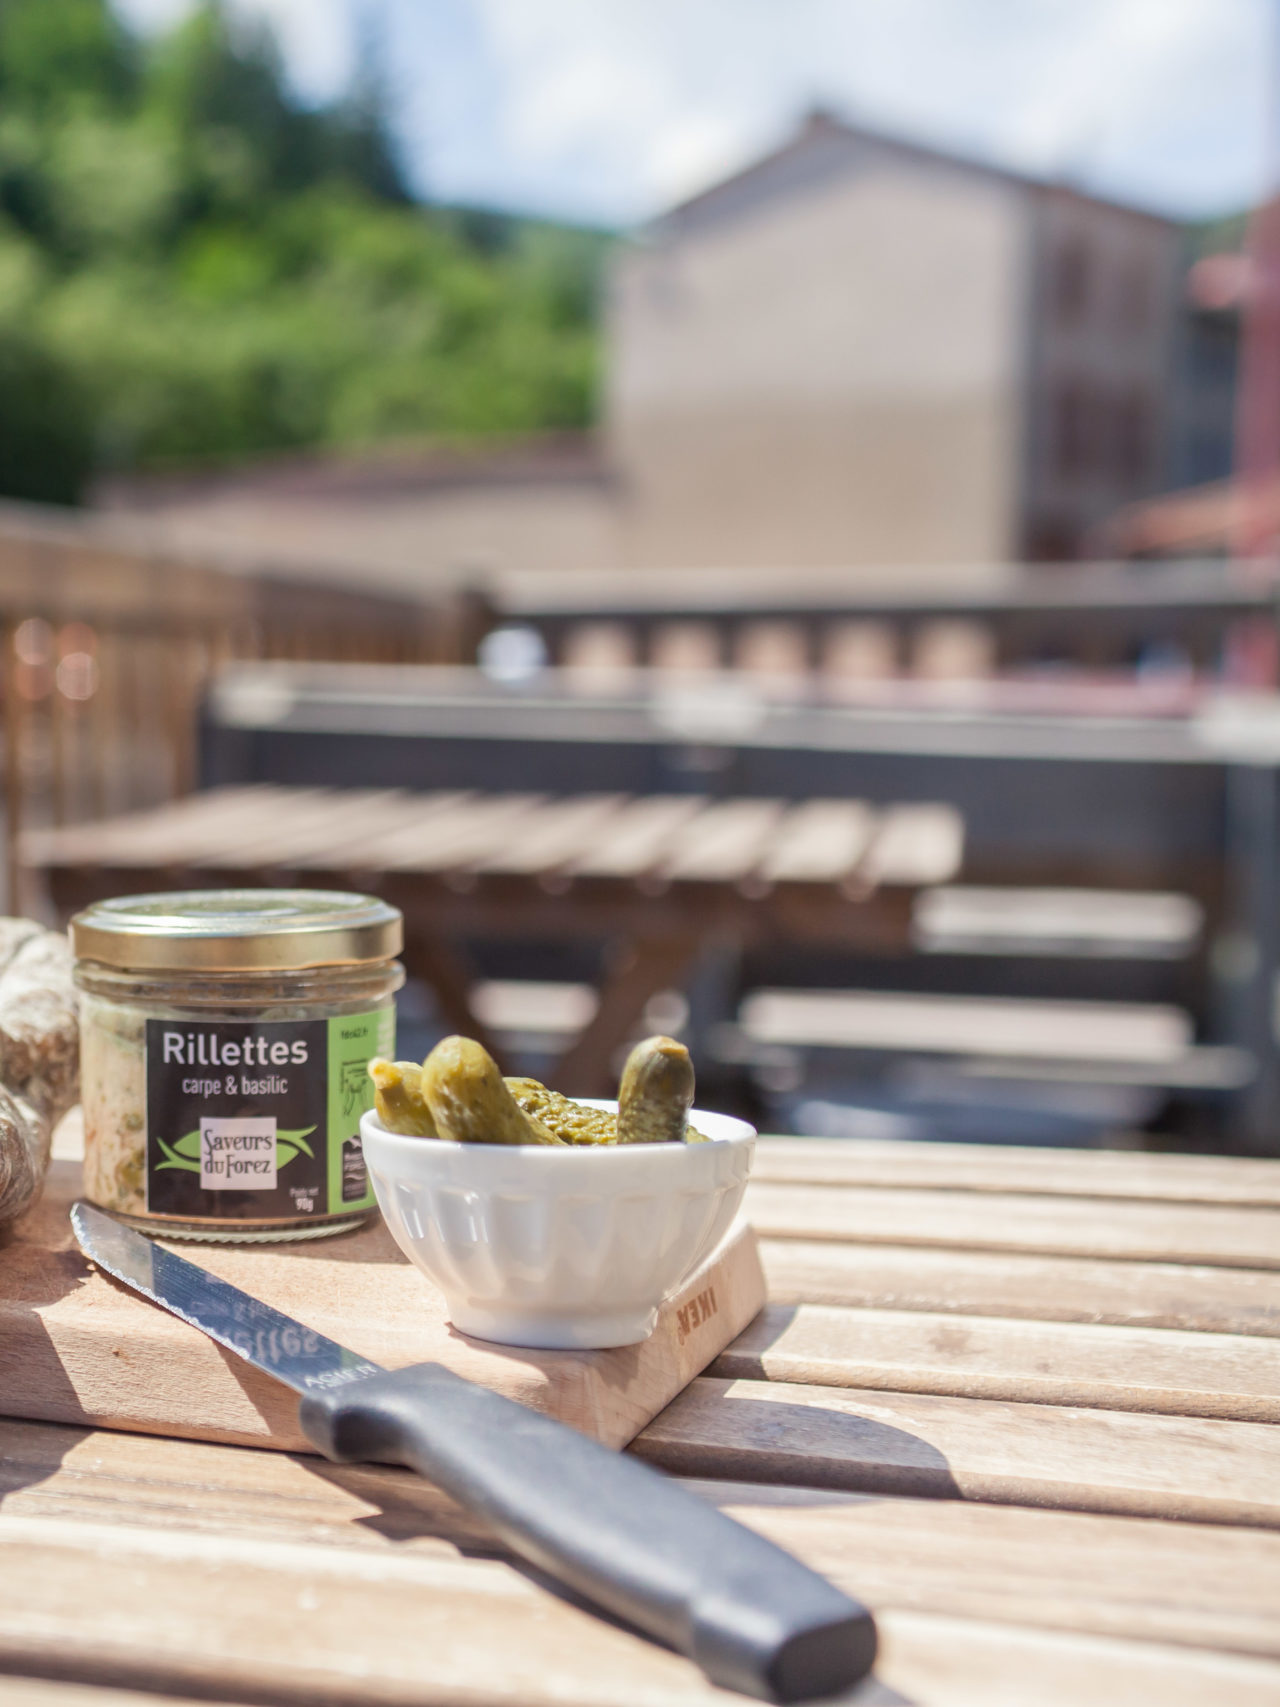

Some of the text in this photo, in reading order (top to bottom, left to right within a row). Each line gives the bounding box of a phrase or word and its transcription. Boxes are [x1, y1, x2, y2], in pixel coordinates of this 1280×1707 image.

[163, 1031, 309, 1066] Rillettes
[182, 1074, 289, 1099] carpe & basilic
[204, 1129, 273, 1156] Saveurs
[676, 1286, 718, 1337] IKEA
